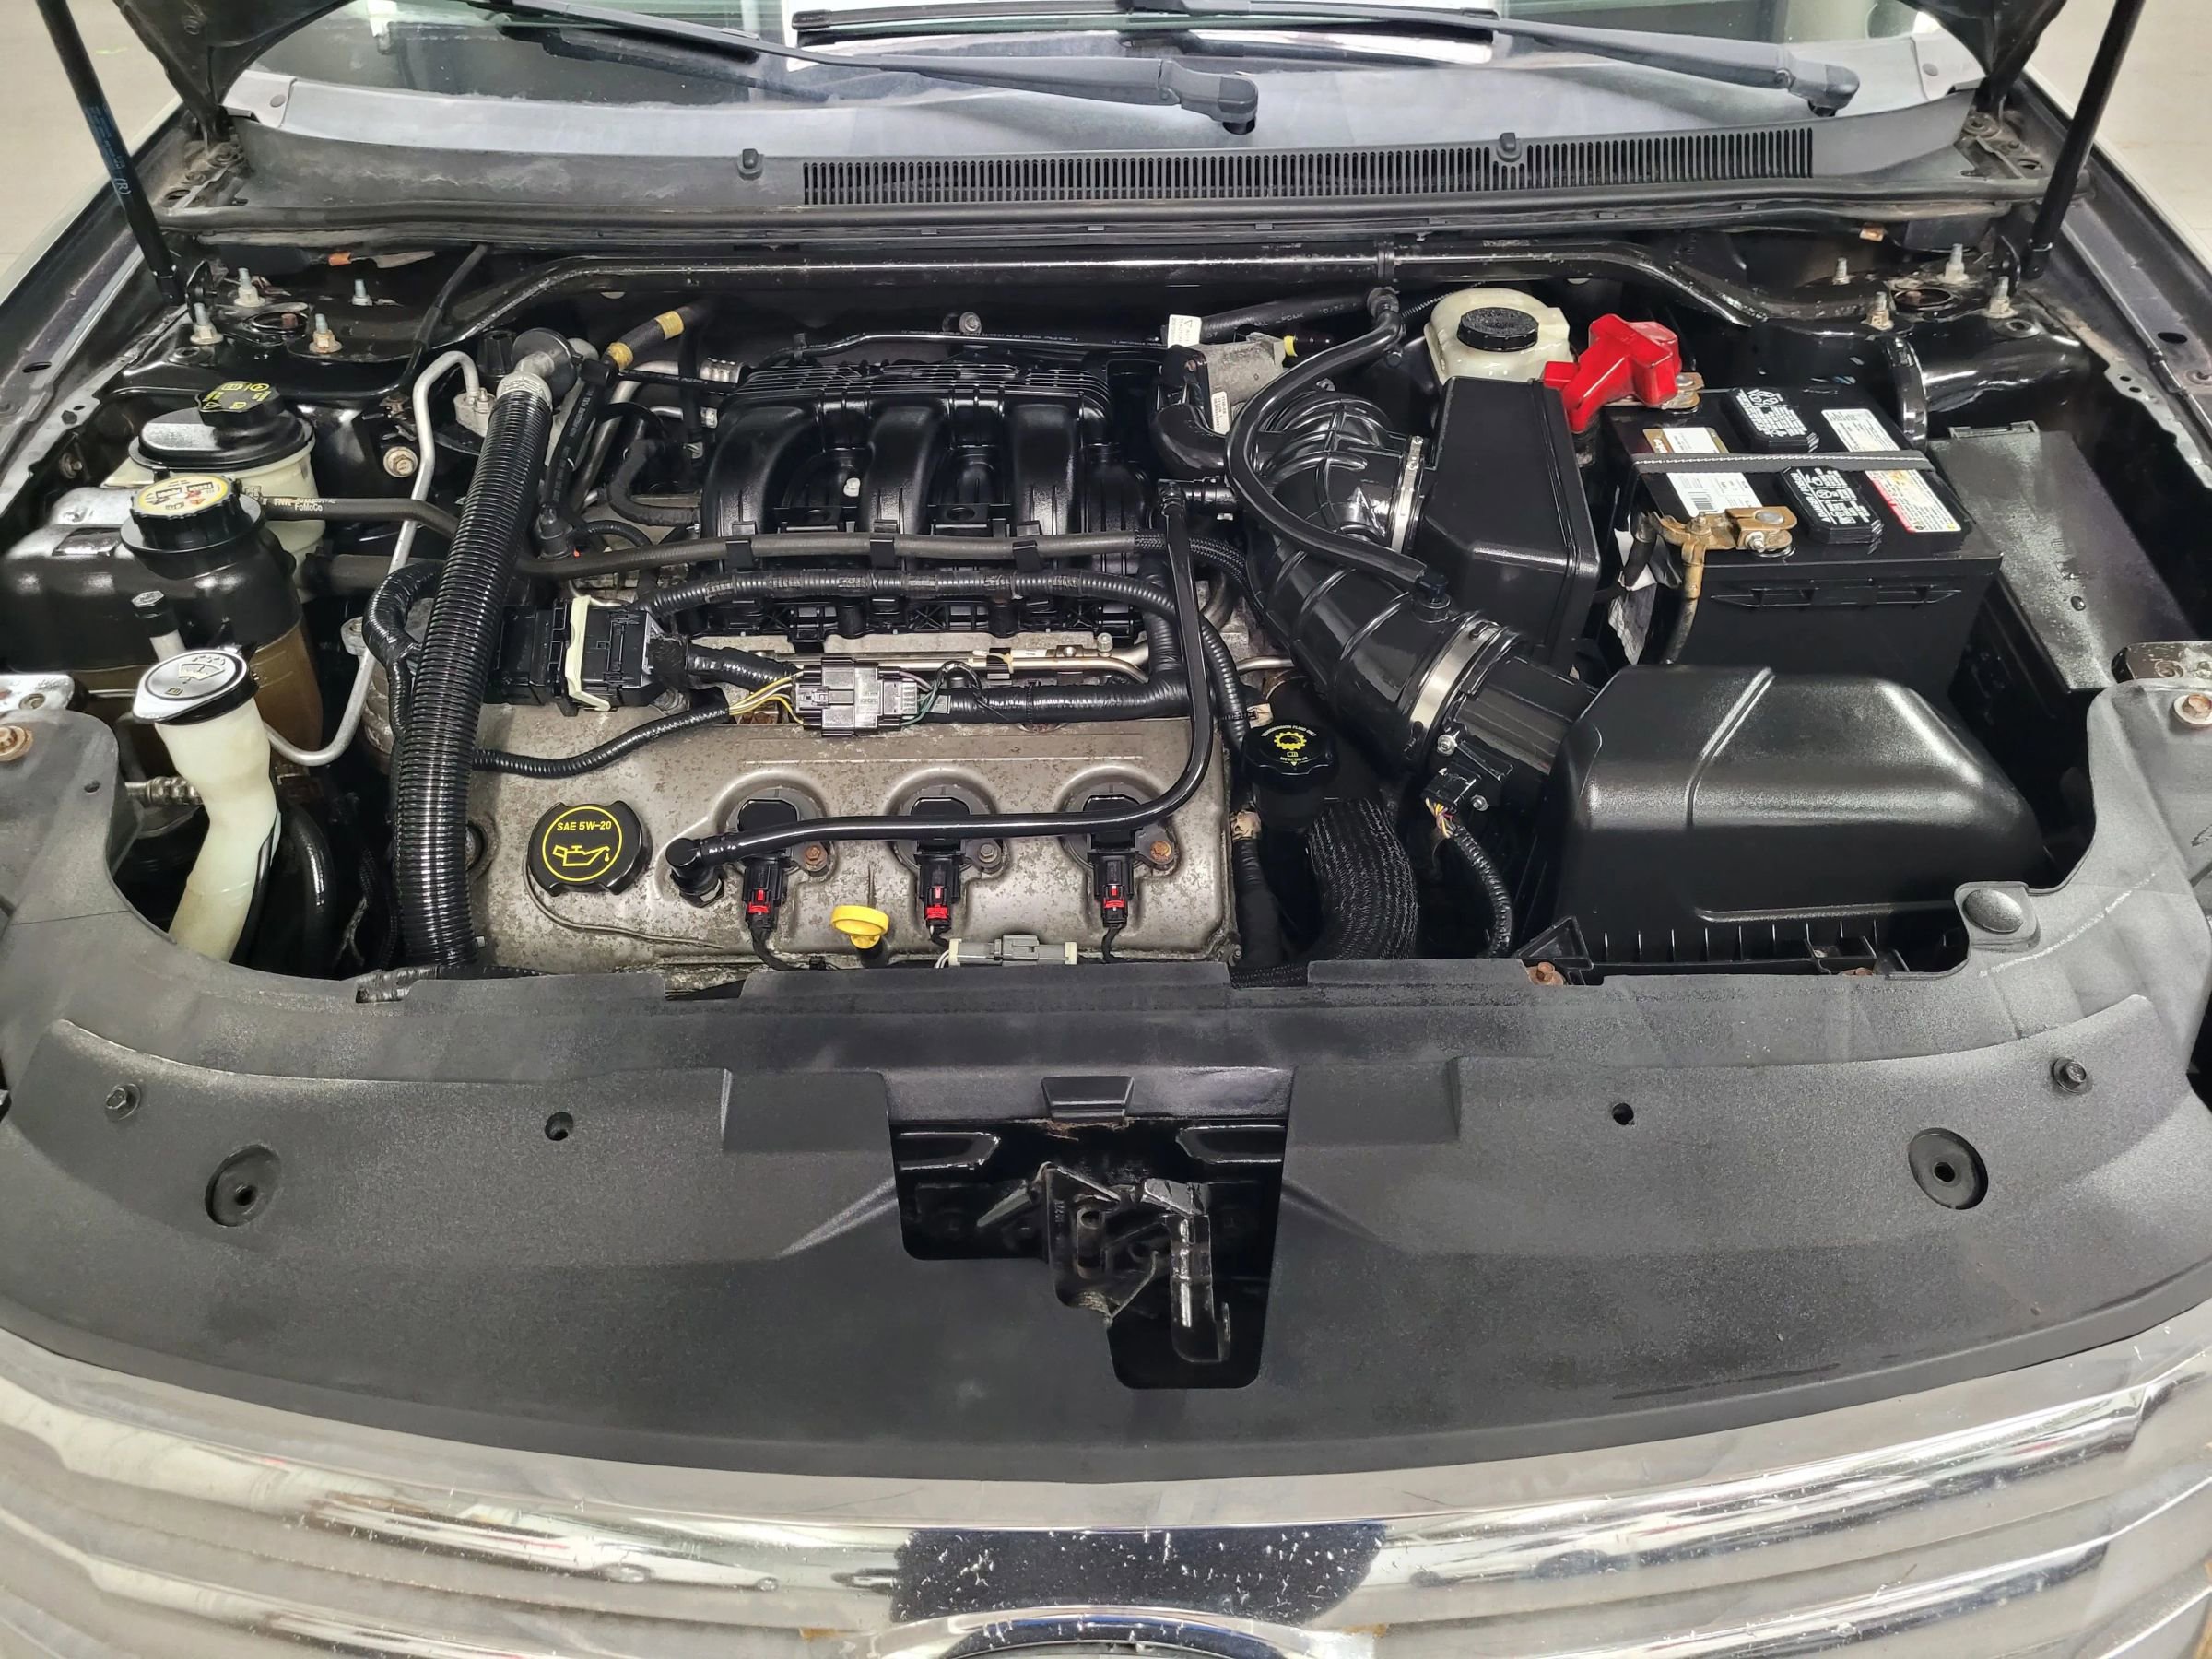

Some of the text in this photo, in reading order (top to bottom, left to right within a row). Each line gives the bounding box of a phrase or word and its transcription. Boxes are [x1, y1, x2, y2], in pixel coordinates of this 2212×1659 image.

[294, 502, 323, 511] FoMoCo
[557, 820, 612, 831] SAE 5W-20
